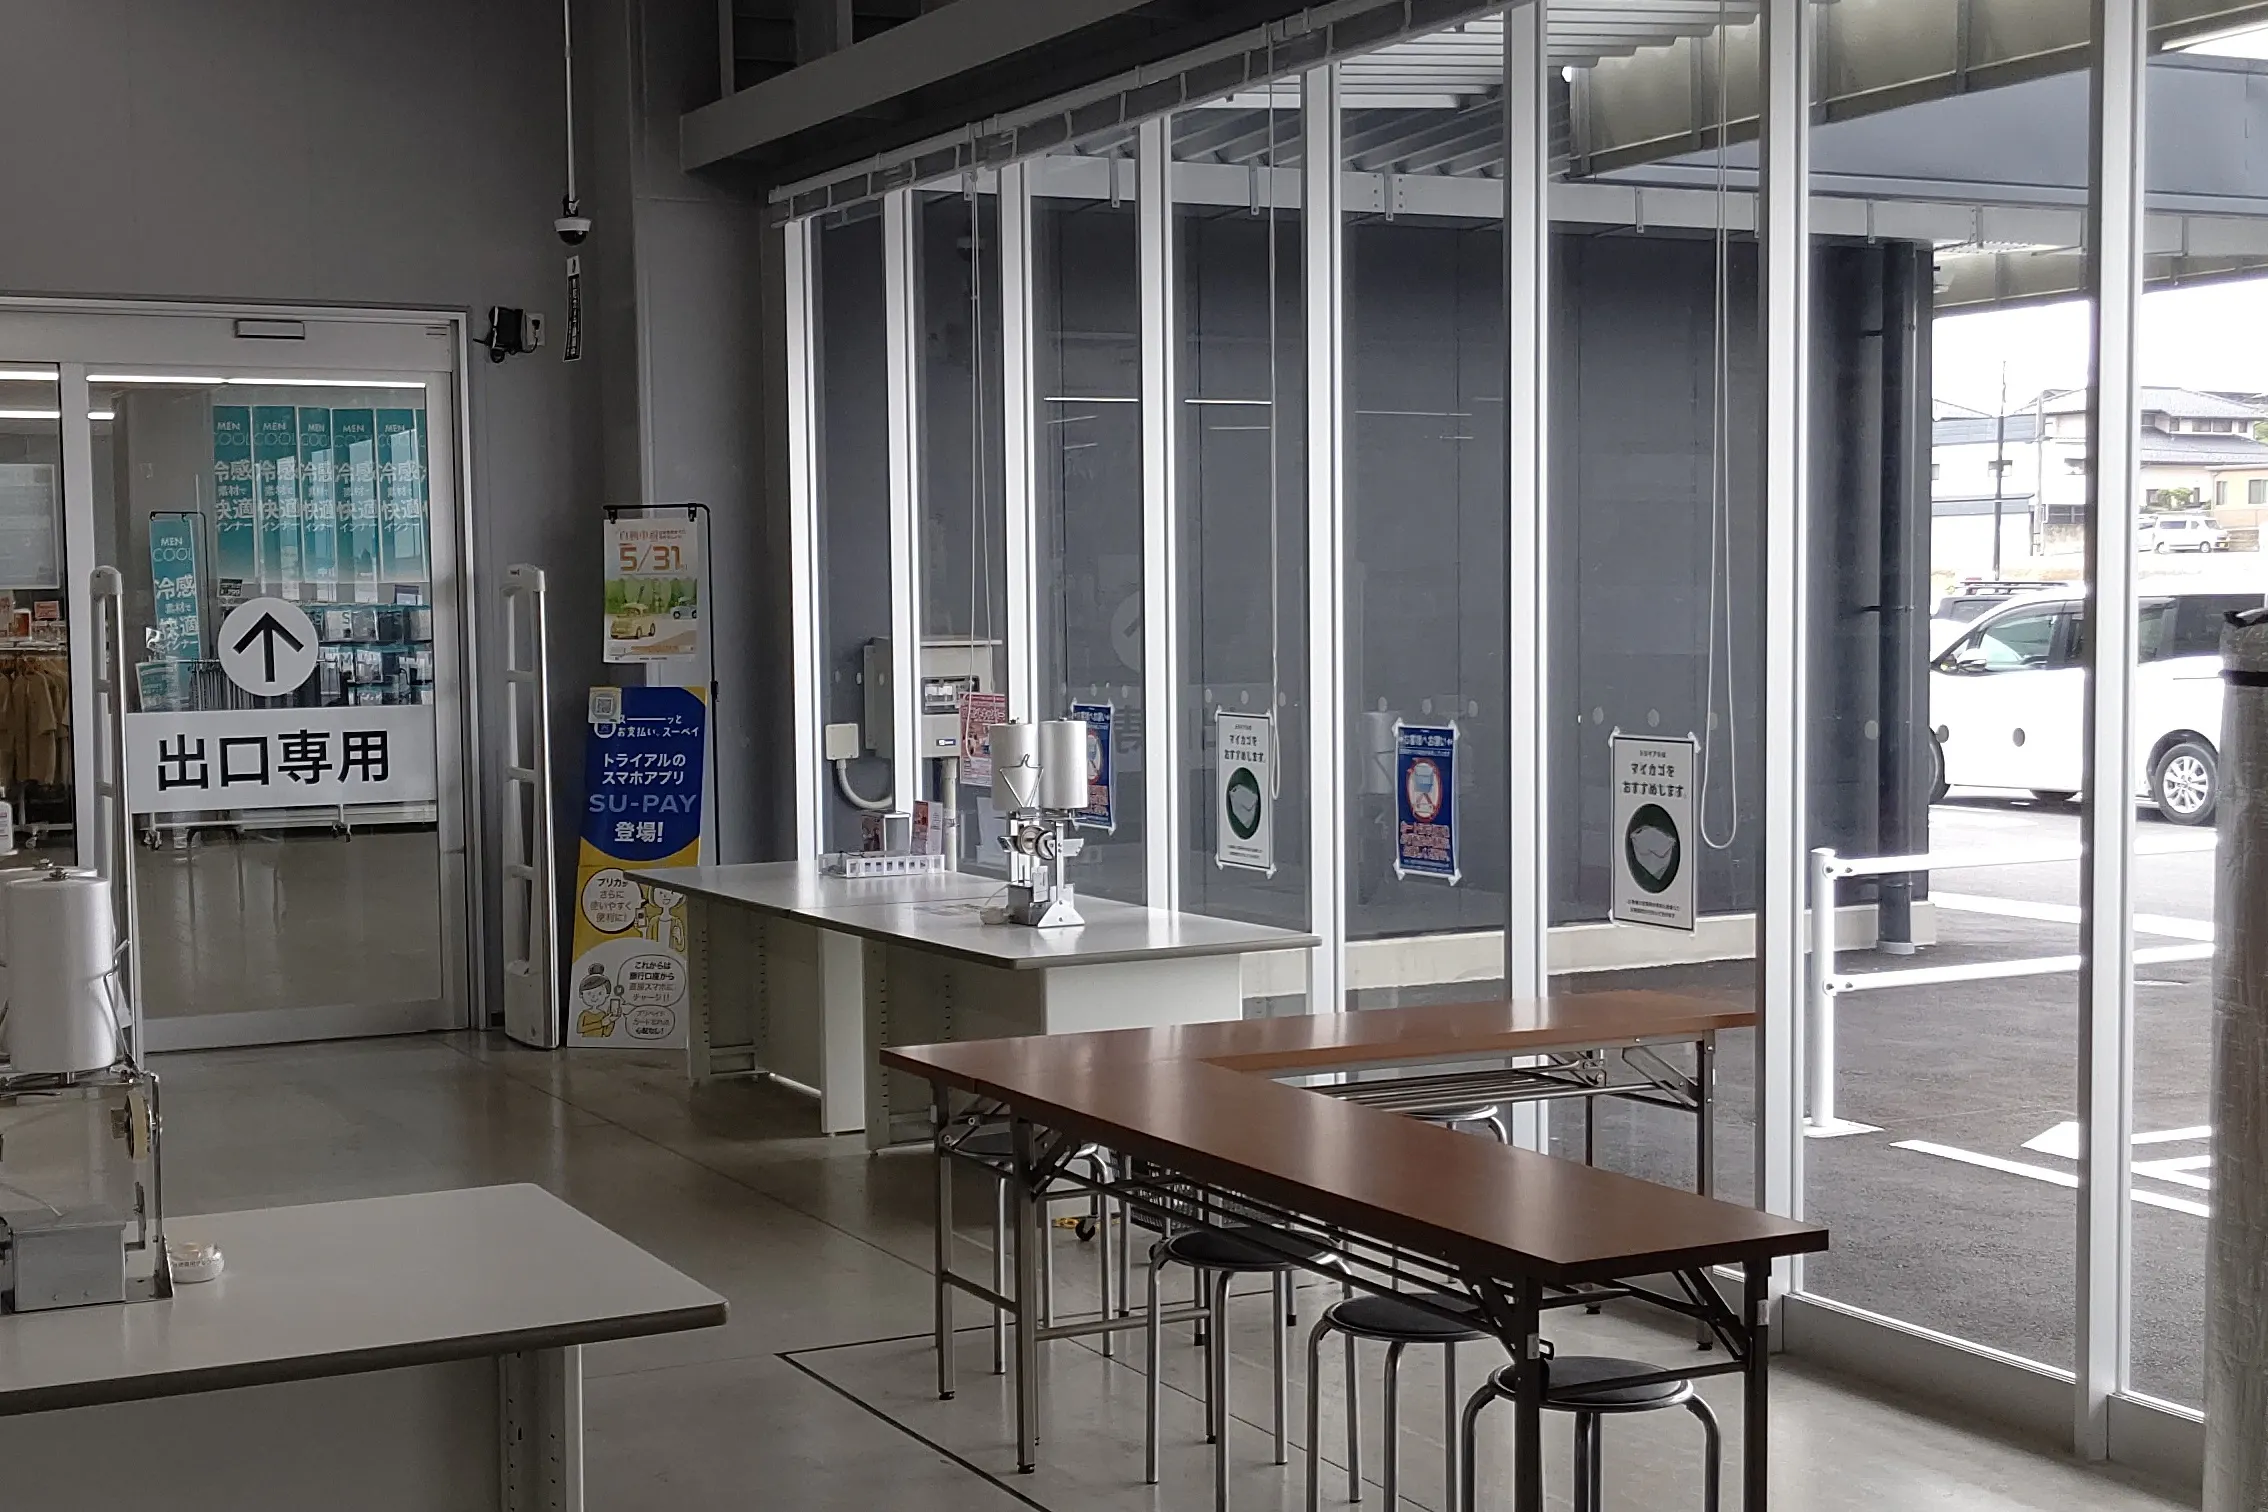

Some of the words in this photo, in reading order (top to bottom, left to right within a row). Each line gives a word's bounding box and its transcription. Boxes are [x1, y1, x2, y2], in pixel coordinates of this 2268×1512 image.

[217, 422, 240, 431] MEN
[263, 422, 286, 431] MEN
[343, 424, 365, 433] MEN
[160, 537, 183, 546] MEN
[155, 574, 196, 600] 冷感
[157, 728, 390, 792] 出口専用
[604, 753, 686, 768] トライアルの
[1631, 763, 1676, 778] マイカゴを
[602, 771, 685, 785] スマホアプリ
[588, 793, 697, 813] SU-PAY
[614, 821, 664, 843] 登場!
[600, 890, 625, 899] さらに
[634, 961, 672, 970] これからは
[629, 972, 675, 981] 銀行口座から
